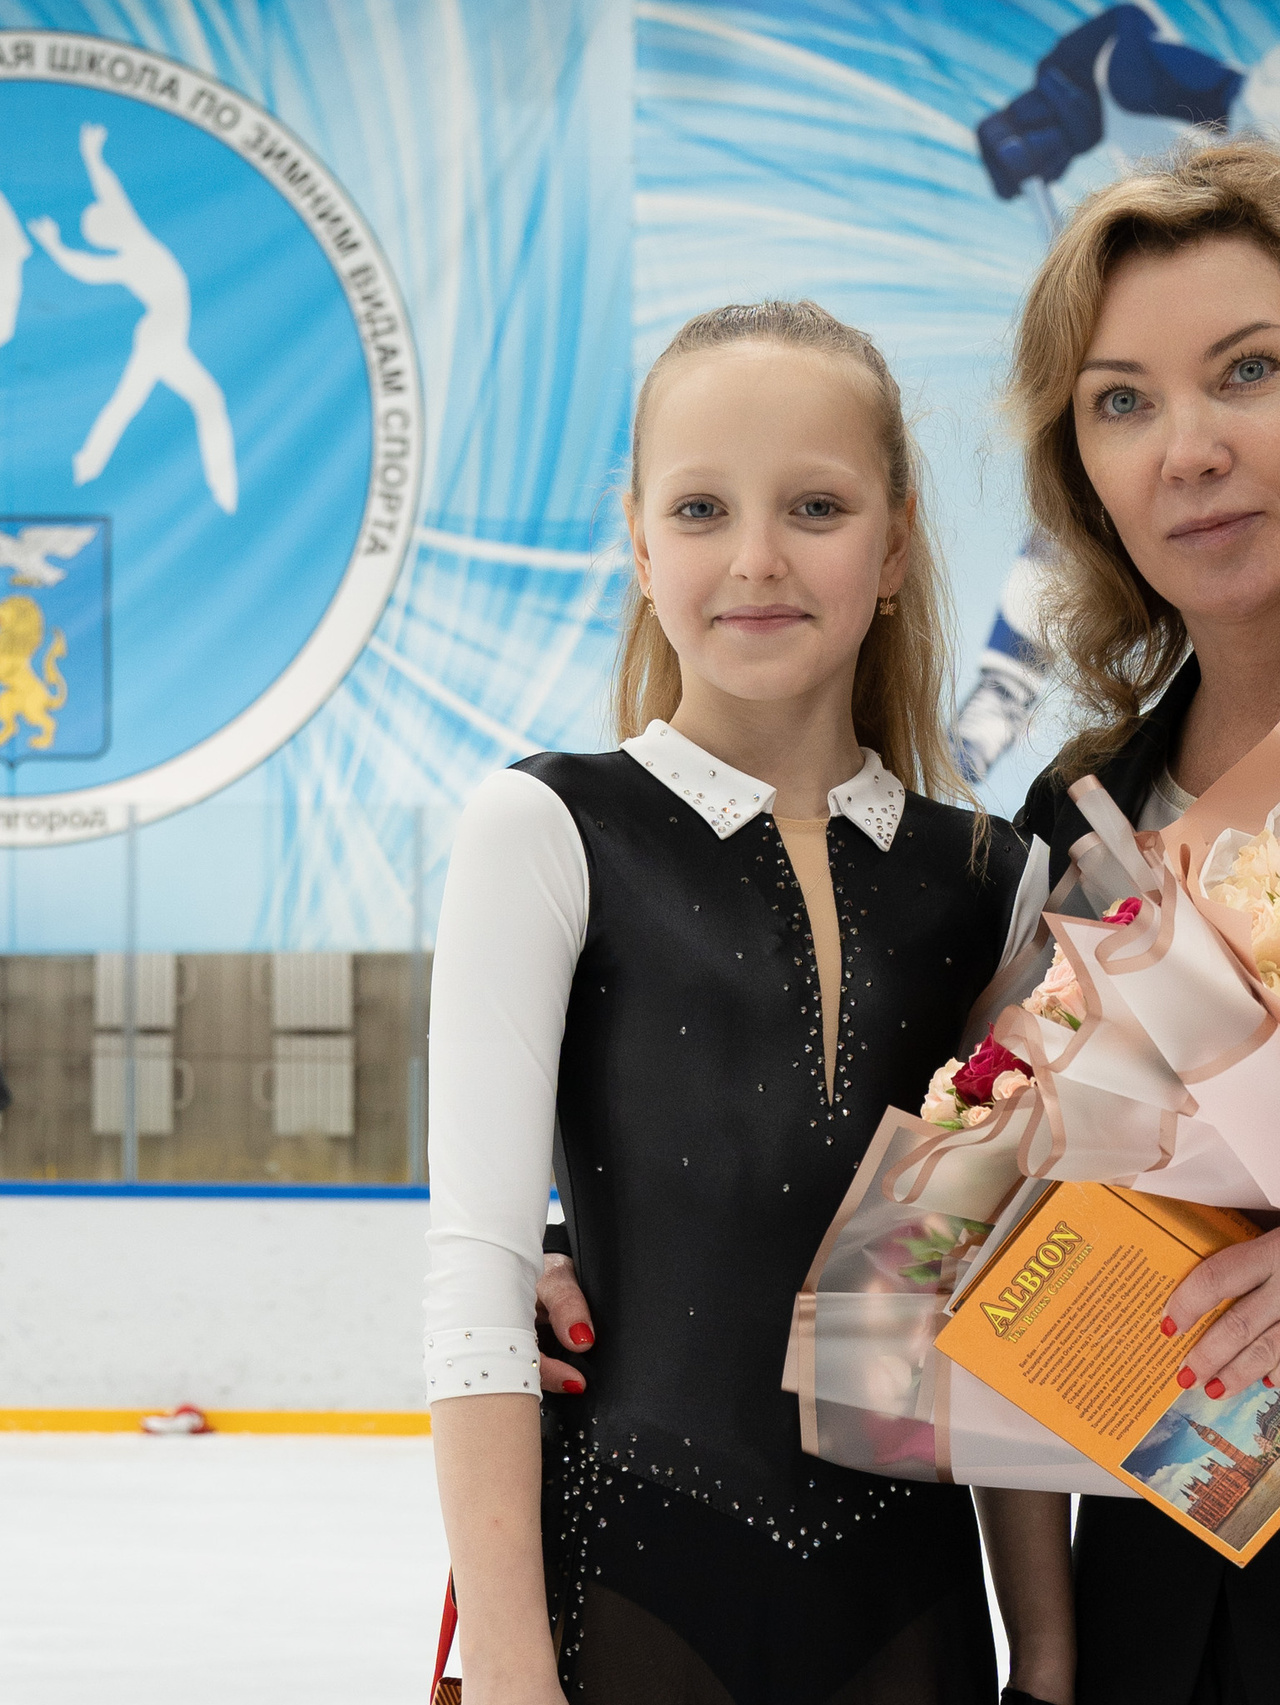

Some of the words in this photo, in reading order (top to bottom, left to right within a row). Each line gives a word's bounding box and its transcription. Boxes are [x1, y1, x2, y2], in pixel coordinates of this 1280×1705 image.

[49, 41, 180, 101] ШКОЛА
[188, 86, 242, 132] ПО
[244, 122, 361, 257] ЗИМНИМ
[350, 262, 405, 397] ВИДАМ
[362, 406, 411, 557] СПОРТА
[980, 1221, 1083, 1338] ALBION
[1069, 1285, 1089, 1306] часовой
[1094, 1297, 1102, 1305] по
[1099, 1276, 1120, 1298] дизайну
[1115, 1247, 1144, 1278] английского
[1021, 1338, 1056, 1377] Расширительно
[1084, 1275, 1109, 1303] именуются
[1106, 1261, 1121, 1276] также
[1119, 1248, 1131, 1261] часы
[1087, 1360, 1105, 1379] Высота
[1125, 1319, 1140, 1336] метра
[1162, 1277, 1175, 1290] часы
[1092, 1334, 1115, 1360] ошибочно
[1136, 1299, 1145, 1309] как
[1038, 1355, 1065, 1386] архитектора
[1049, 1372, 1062, 1385] часы
[1059, 1352, 1078, 1374] пущены
[1079, 1339, 1089, 1350] ход
[1099, 1311, 1112, 1324] 1859
[1074, 1373, 1107, 1410] располагаются
[1109, 1349, 1126, 1368] высоте
[1077, 1388, 1105, 1419] циферблата
[1108, 1364, 1125, 1383] метров
[1085, 1409, 1098, 1422] часы
[1096, 1392, 1113, 1411] долгое
[1110, 1377, 1126, 1394] время
[1123, 1353, 1146, 1378] считались
[1117, 1392, 1135, 1412] монеты
[1128, 1404, 1136, 1412] на
[1164, 1349, 1183, 1369] старый
[1090, 1405, 1112, 1429] Точность
[1109, 1395, 1122, 1408] хода
[1114, 1418, 1136, 1441] который
[1132, 1397, 1154, 1420] ускоряет
